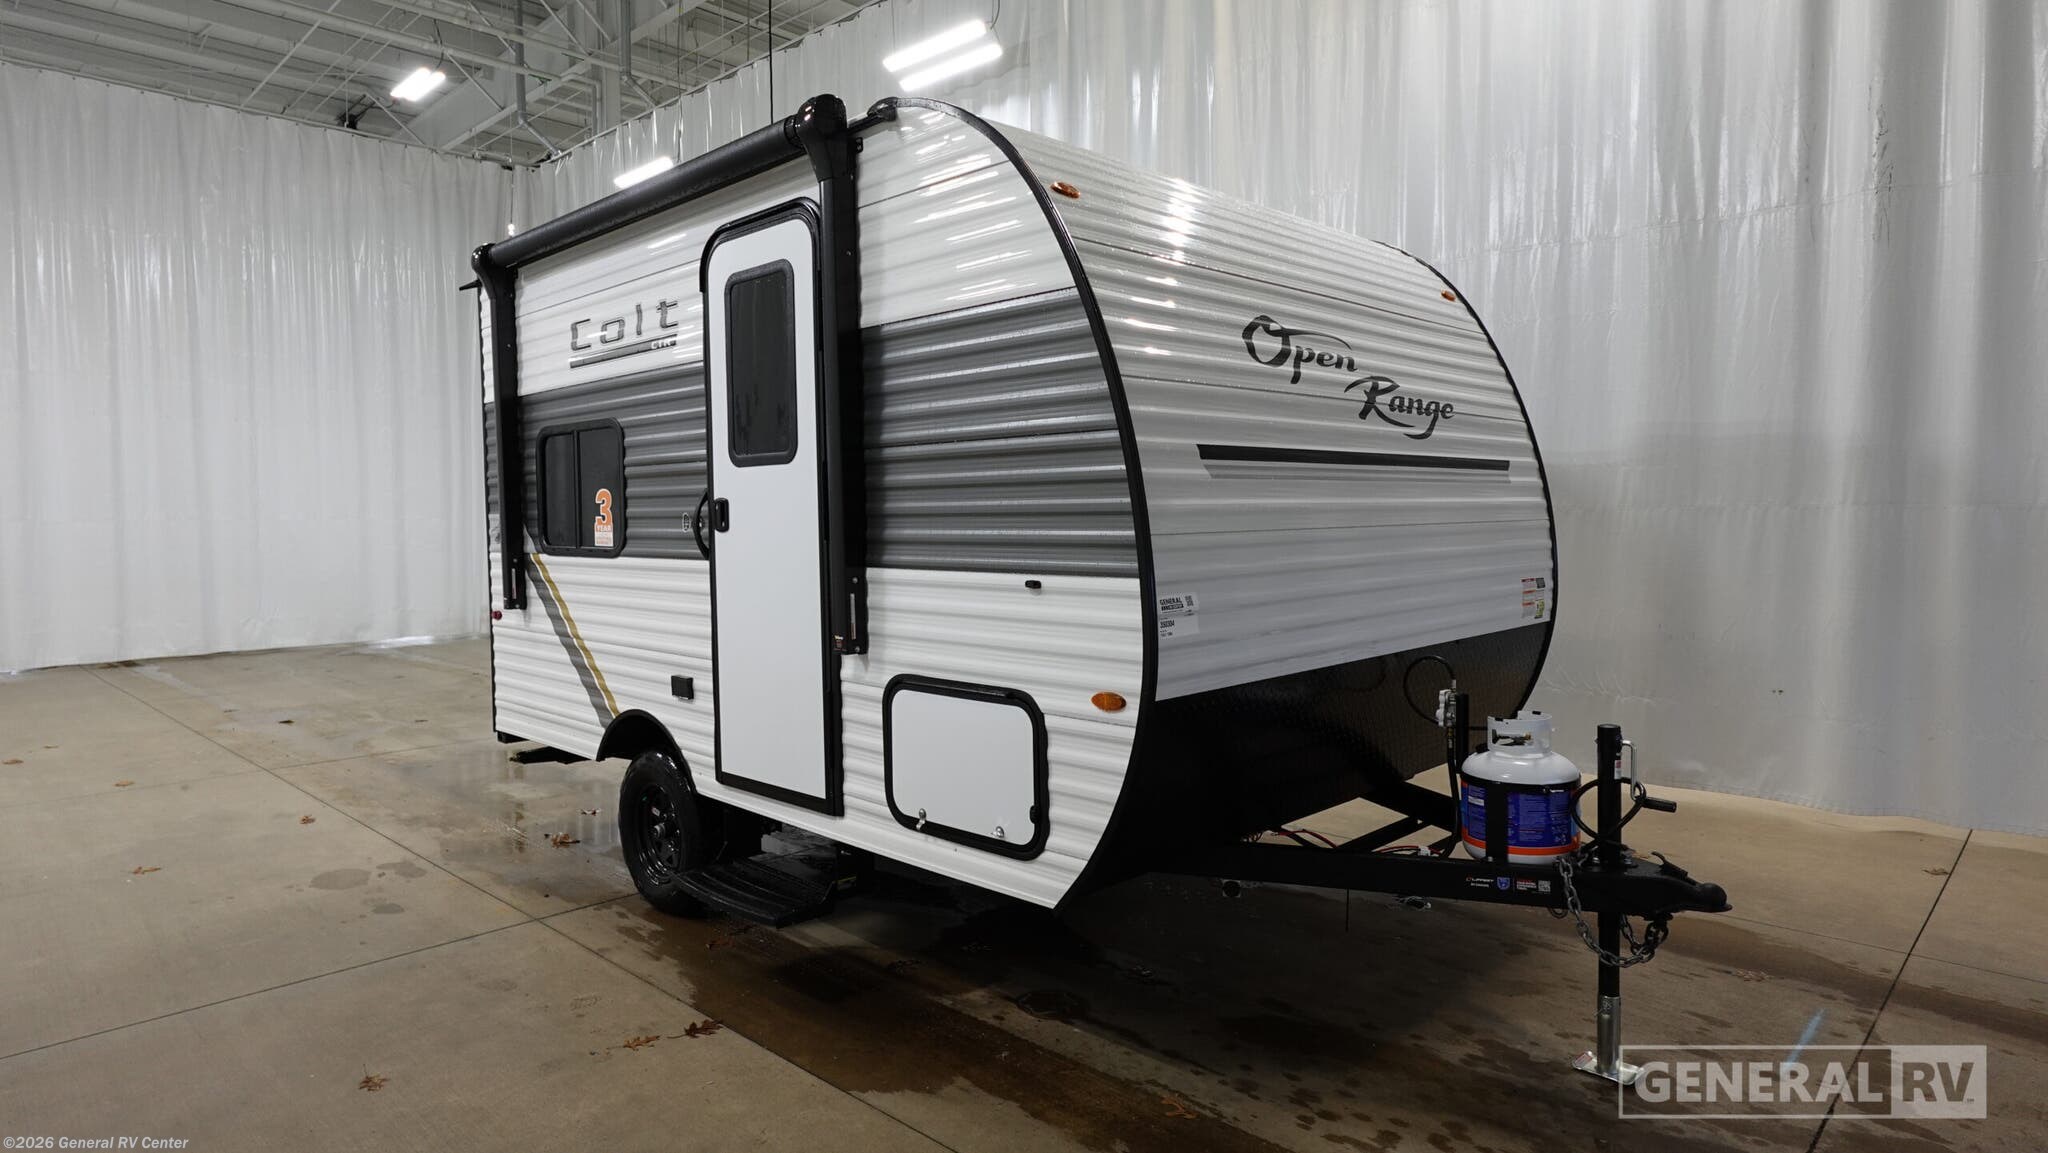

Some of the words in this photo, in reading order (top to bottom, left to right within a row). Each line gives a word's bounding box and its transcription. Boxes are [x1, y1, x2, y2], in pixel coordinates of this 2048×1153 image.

[570, 301, 678, 351] Colt
[1242, 315, 1358, 385] Open
[1344, 375, 1455, 440] Range
[595, 488, 612, 525] 3
